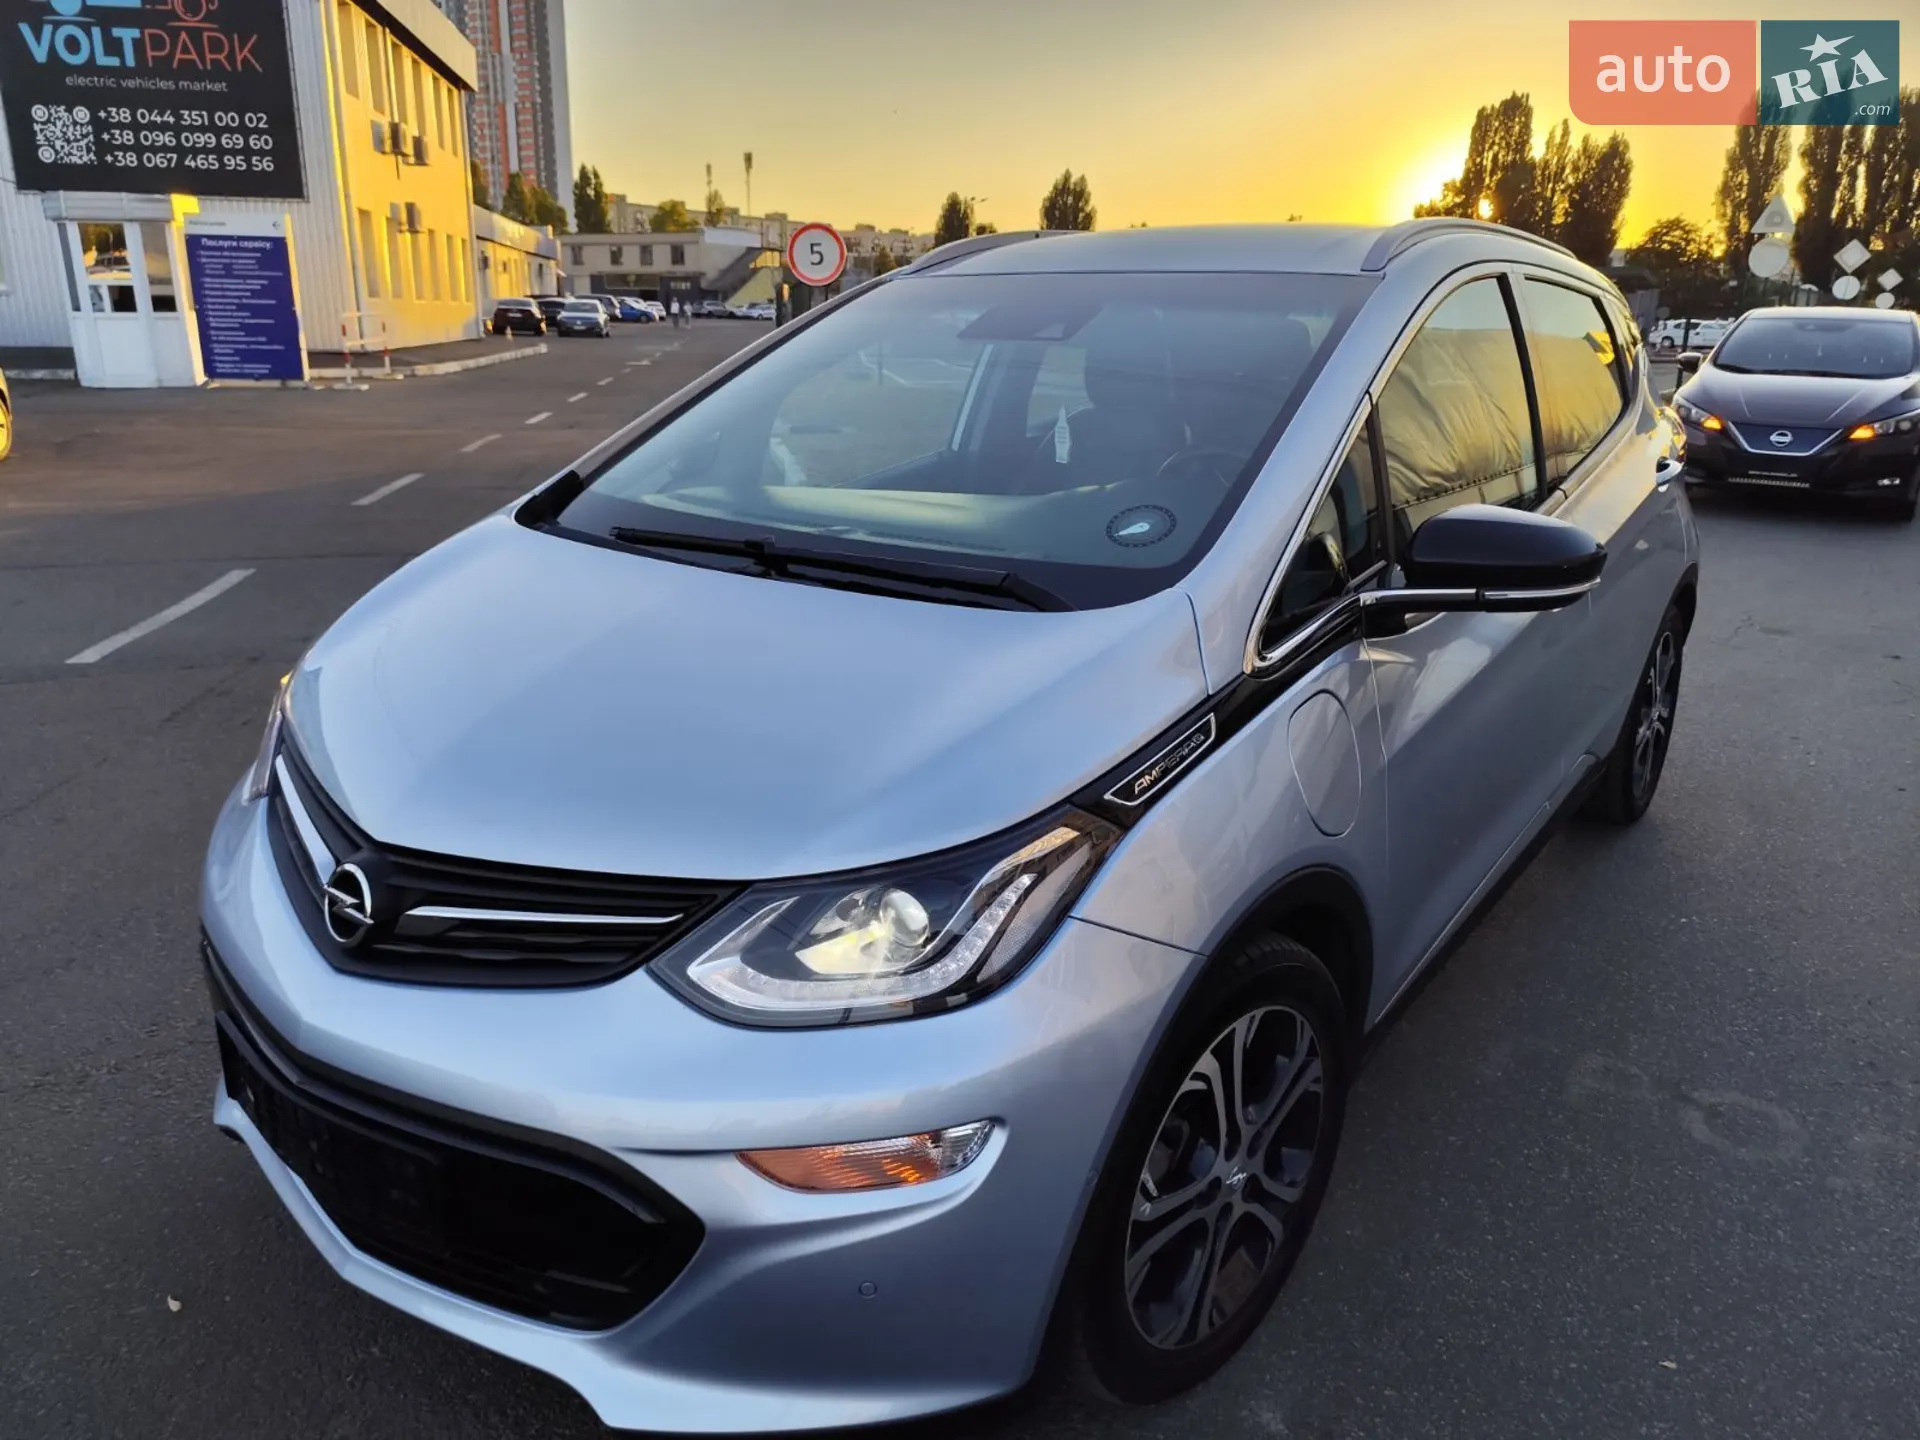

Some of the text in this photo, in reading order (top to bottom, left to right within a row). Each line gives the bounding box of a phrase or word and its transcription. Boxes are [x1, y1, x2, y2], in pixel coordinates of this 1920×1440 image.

[65, 74, 229, 93] electric vehicles market
[97, 107, 269, 129] +38 044 351 00 02
[101, 130, 274, 151] +38 096 099 69 60
[104, 152, 275, 172] +38 067 465 95 56
[201, 237, 238, 249] Послуги
[810, 243, 824, 266] 5
